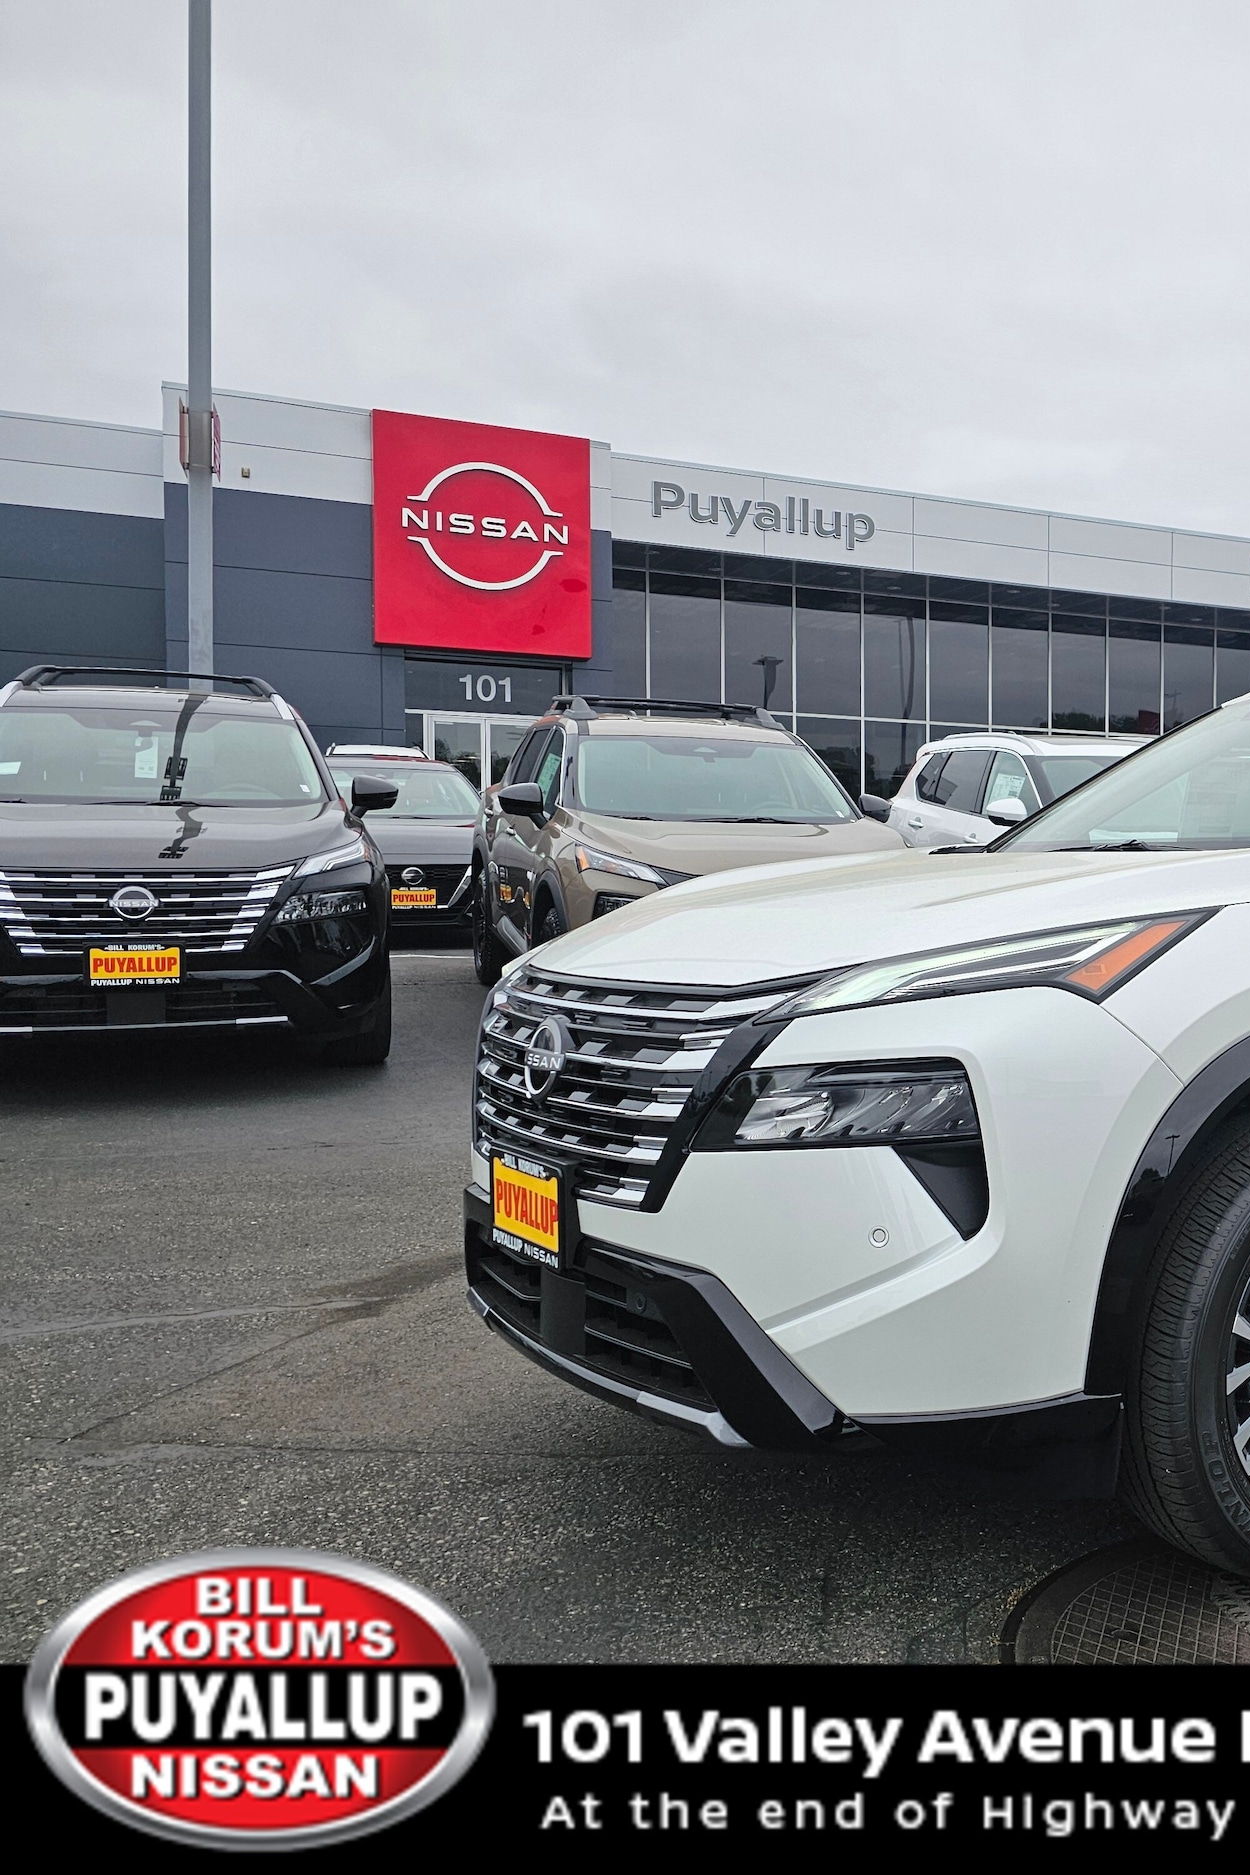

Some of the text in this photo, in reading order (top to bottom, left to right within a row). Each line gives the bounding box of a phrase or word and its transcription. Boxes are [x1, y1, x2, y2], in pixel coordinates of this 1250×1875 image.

[401, 507, 569, 545] NISSAN
[651, 480, 876, 550] Puyallup
[458, 673, 512, 703] 101
[109, 900, 159, 908] NISSAN
[393, 894, 434, 902] PUYALLUP
[93, 957, 177, 973] PUYALLUP
[527, 1053, 561, 1069] SSAN
[496, 1178, 559, 1236] PUYALLUP
[492, 1228, 559, 1268] PUYALLUP NISSAN
